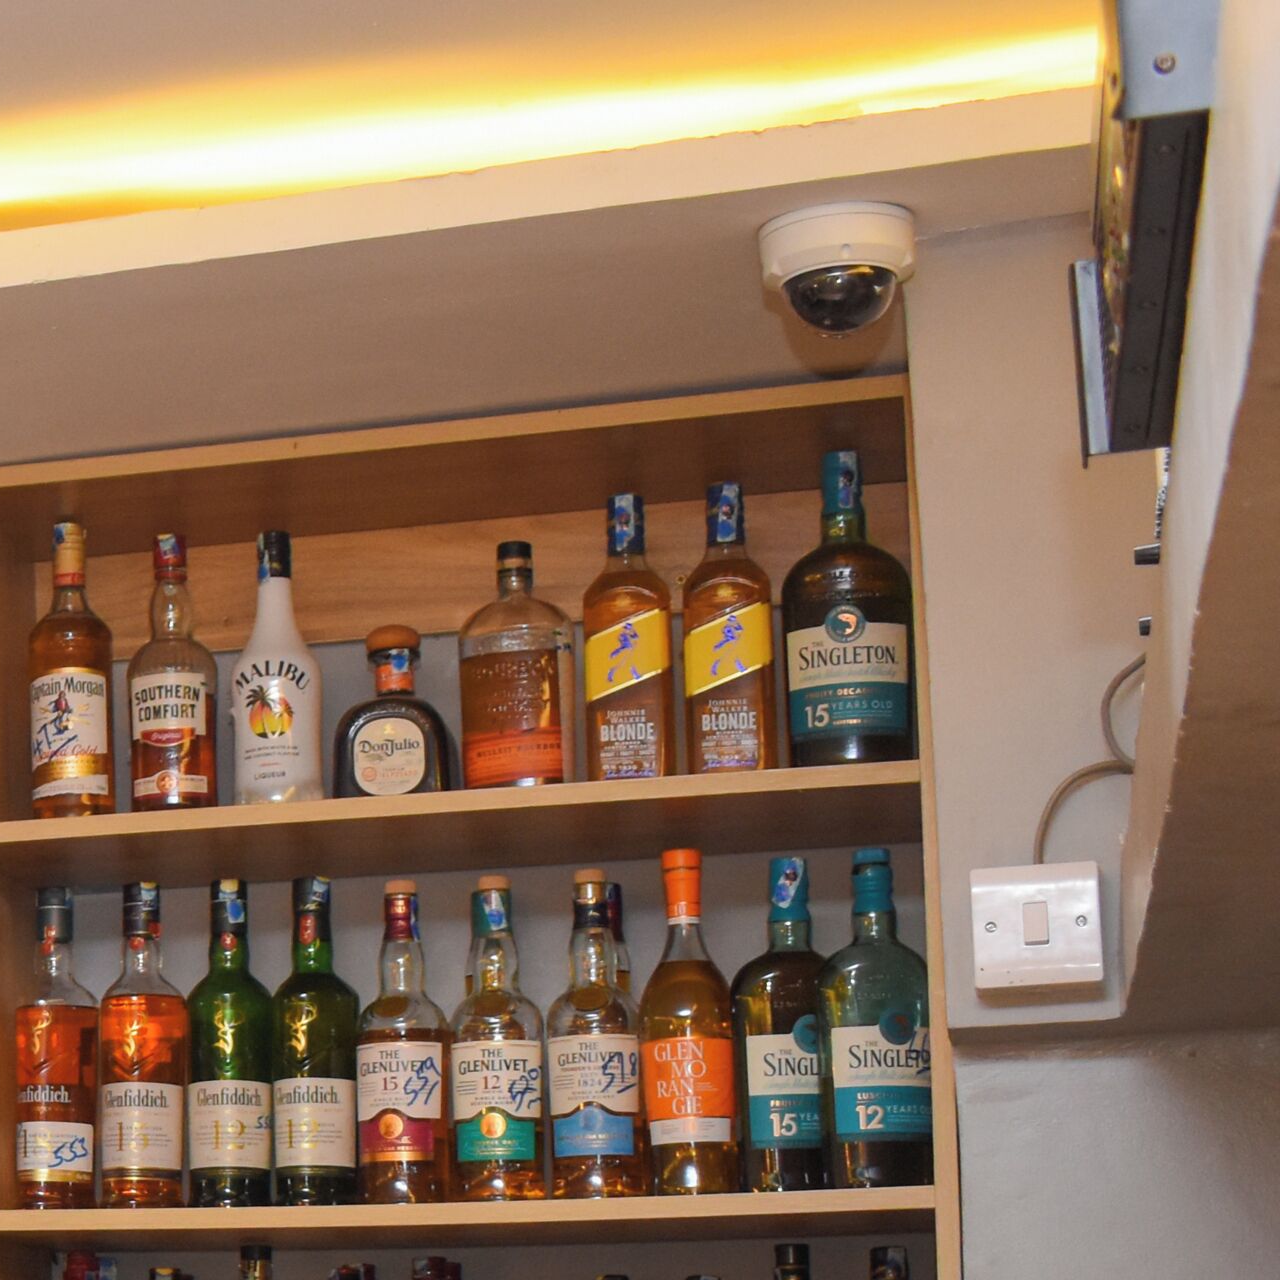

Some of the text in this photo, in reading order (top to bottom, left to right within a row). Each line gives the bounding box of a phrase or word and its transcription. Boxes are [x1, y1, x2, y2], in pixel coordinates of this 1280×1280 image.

[798, 645, 897, 671] SINGLETON
[235, 660, 311, 694] MALIBU
[134, 684, 201, 706] SOUTHERN
[139, 704, 197, 722] COMFORT
[701, 711, 757, 732] BLONDE
[805, 703, 830, 729] 15
[600, 722, 655, 742] BLONDE
[379, 1050, 400, 1059] THE
[481, 1049, 503, 1058] THE
[654, 1040, 705, 1062] GLEN
[459, 1059, 528, 1075] GLENLIVET
[763, 1053, 820, 1077] SINGL
[382, 1076, 398, 1091] 15
[482, 1075, 501, 1090] 12
[657, 1078, 695, 1098] RAN
[104, 1088, 169, 1108] Glenfiddich
[196, 1087, 262, 1107] Glenfiddich
[274, 1085, 340, 1105] Glenfiddich
[770, 1112, 797, 1137] 15
[799, 1112, 820, 1121] YEA
[856, 1105, 885, 1130] 12
[287, 1118, 320, 1150] 12
